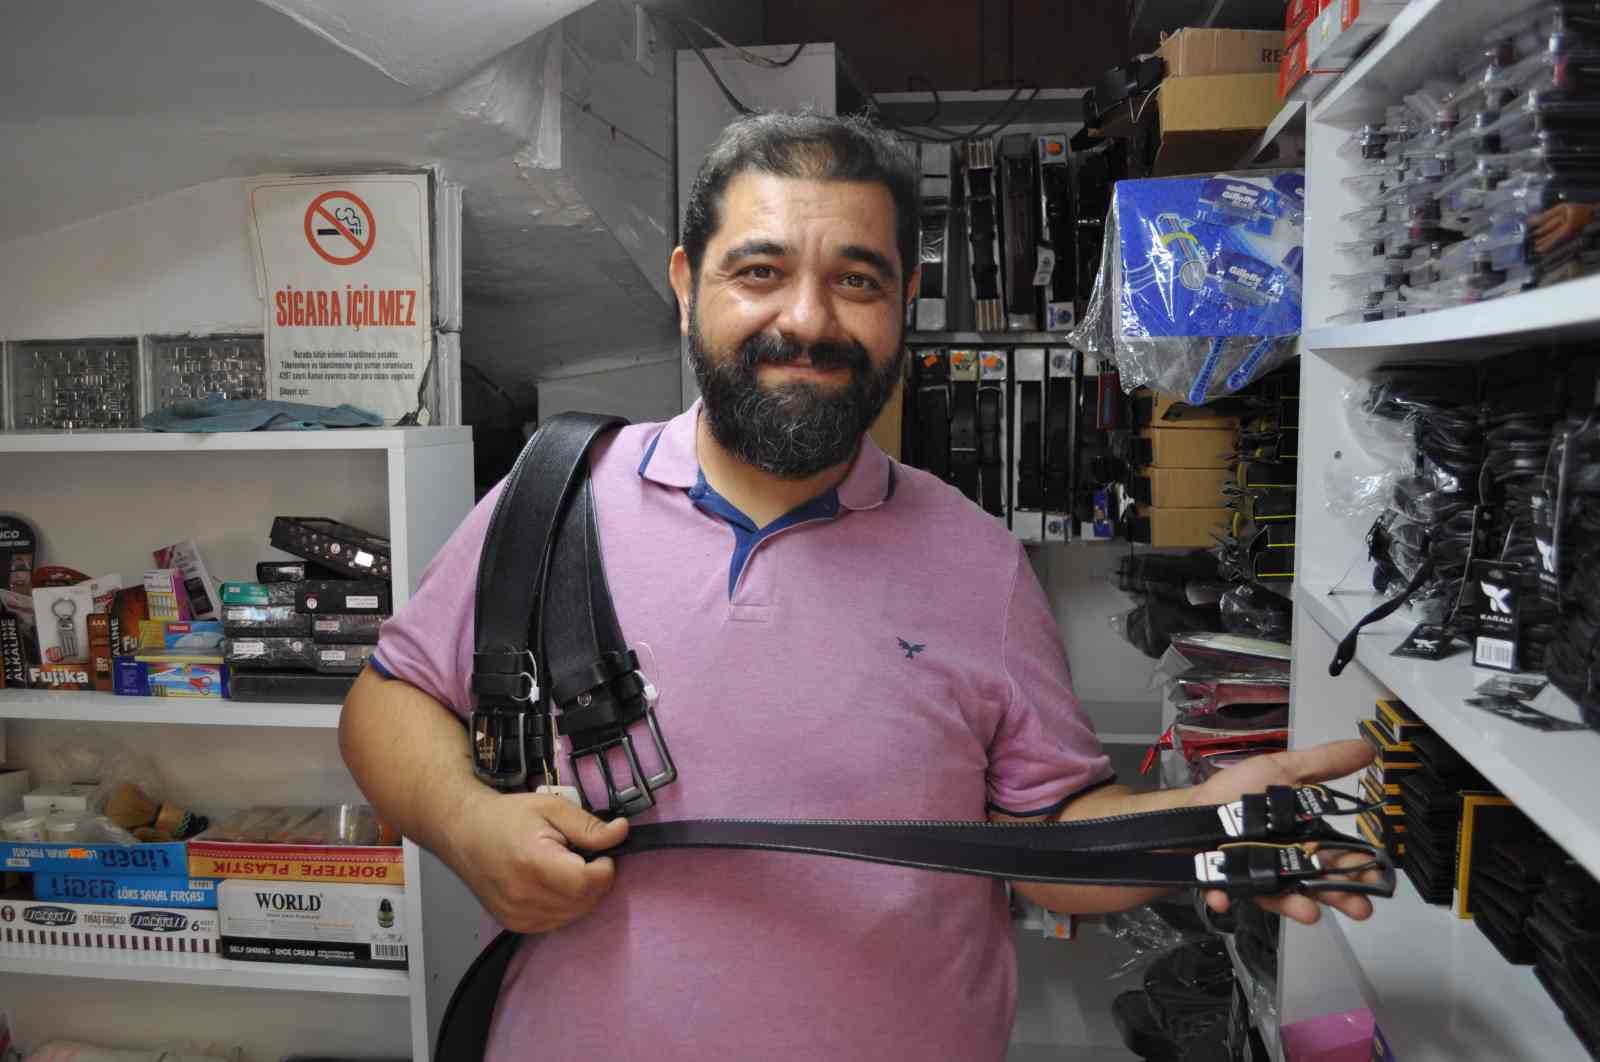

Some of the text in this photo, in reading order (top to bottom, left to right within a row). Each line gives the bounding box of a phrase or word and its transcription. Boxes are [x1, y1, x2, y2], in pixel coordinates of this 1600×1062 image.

[275, 284, 417, 331] SİGARA İÇİLMEZ
[0, 529, 20, 539] CO
[8, 618, 24, 681] ALKALINE
[29, 667, 88, 685] Fujika
[214, 861, 387, 879] BORTEPE PLASTIK
[256, 892, 321, 912] WORLD
